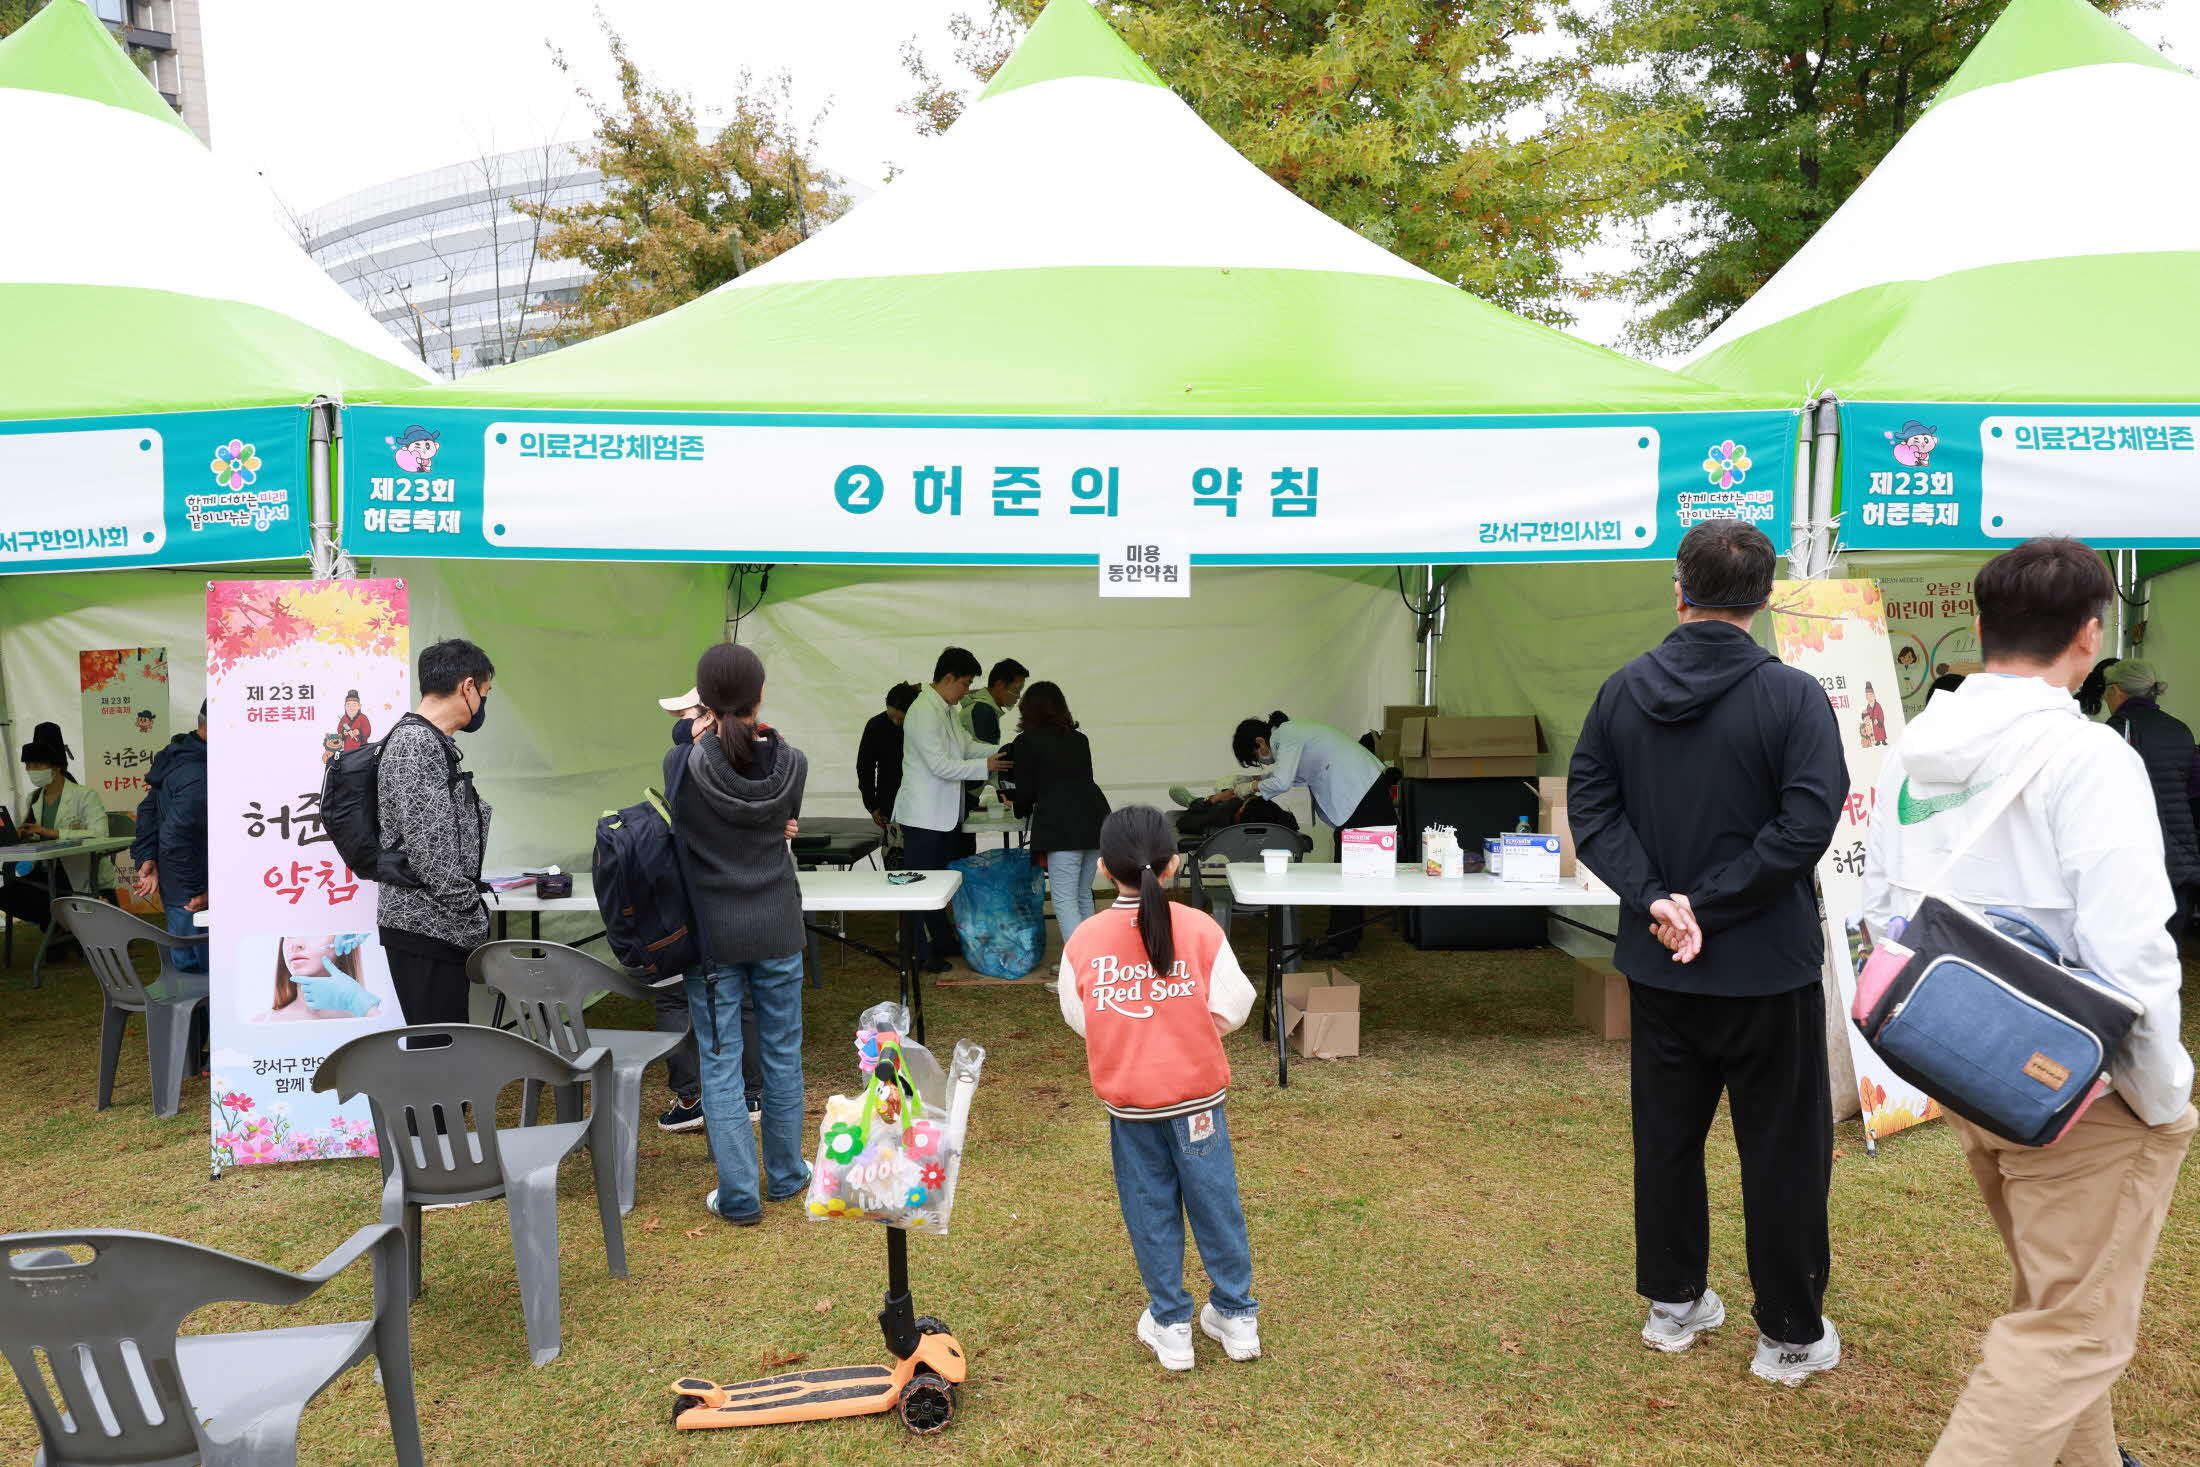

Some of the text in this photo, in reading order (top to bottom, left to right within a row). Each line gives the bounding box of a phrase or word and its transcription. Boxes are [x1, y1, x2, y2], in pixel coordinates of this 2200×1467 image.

[519, 432, 705, 461] 의료건강체험존
[2014, 426, 2195, 451] 의료건강체험존
[369, 477, 456, 503] 제23회
[1868, 471, 1954, 496] 제23회
[186, 491, 287, 513] 함께 더하는 미래
[1679, 491, 1773, 509] 함께 더하는 미래
[186, 505, 288, 530] 같이 나누는 강서
[363, 507, 462, 534] 허준축제
[1678, 509, 1702, 526] 같이
[1862, 501, 1960, 527] 허준축제
[1478, 520, 1622, 544] 강서구한의사회
[1126, 544, 1161, 563] 미용
[1107, 564, 1179, 583] 동안약침
[1926, 581, 1962, 596] 오늘은
[1886, 599, 1979, 620] 어린이 한의
[247, 684, 315, 701] 제 23 회
[1835, 676, 1847, 690] 회
[247, 706, 315, 722] 허준축제
[103, 747, 154, 769] 허준의
[263, 860, 360, 906] 약침
[1091, 955, 1191, 986] Bostn
[1092, 979, 1196, 1019] Red Sox
[253, 1058, 298, 1075] 강서구
[275, 1077, 305, 1094] 함께
